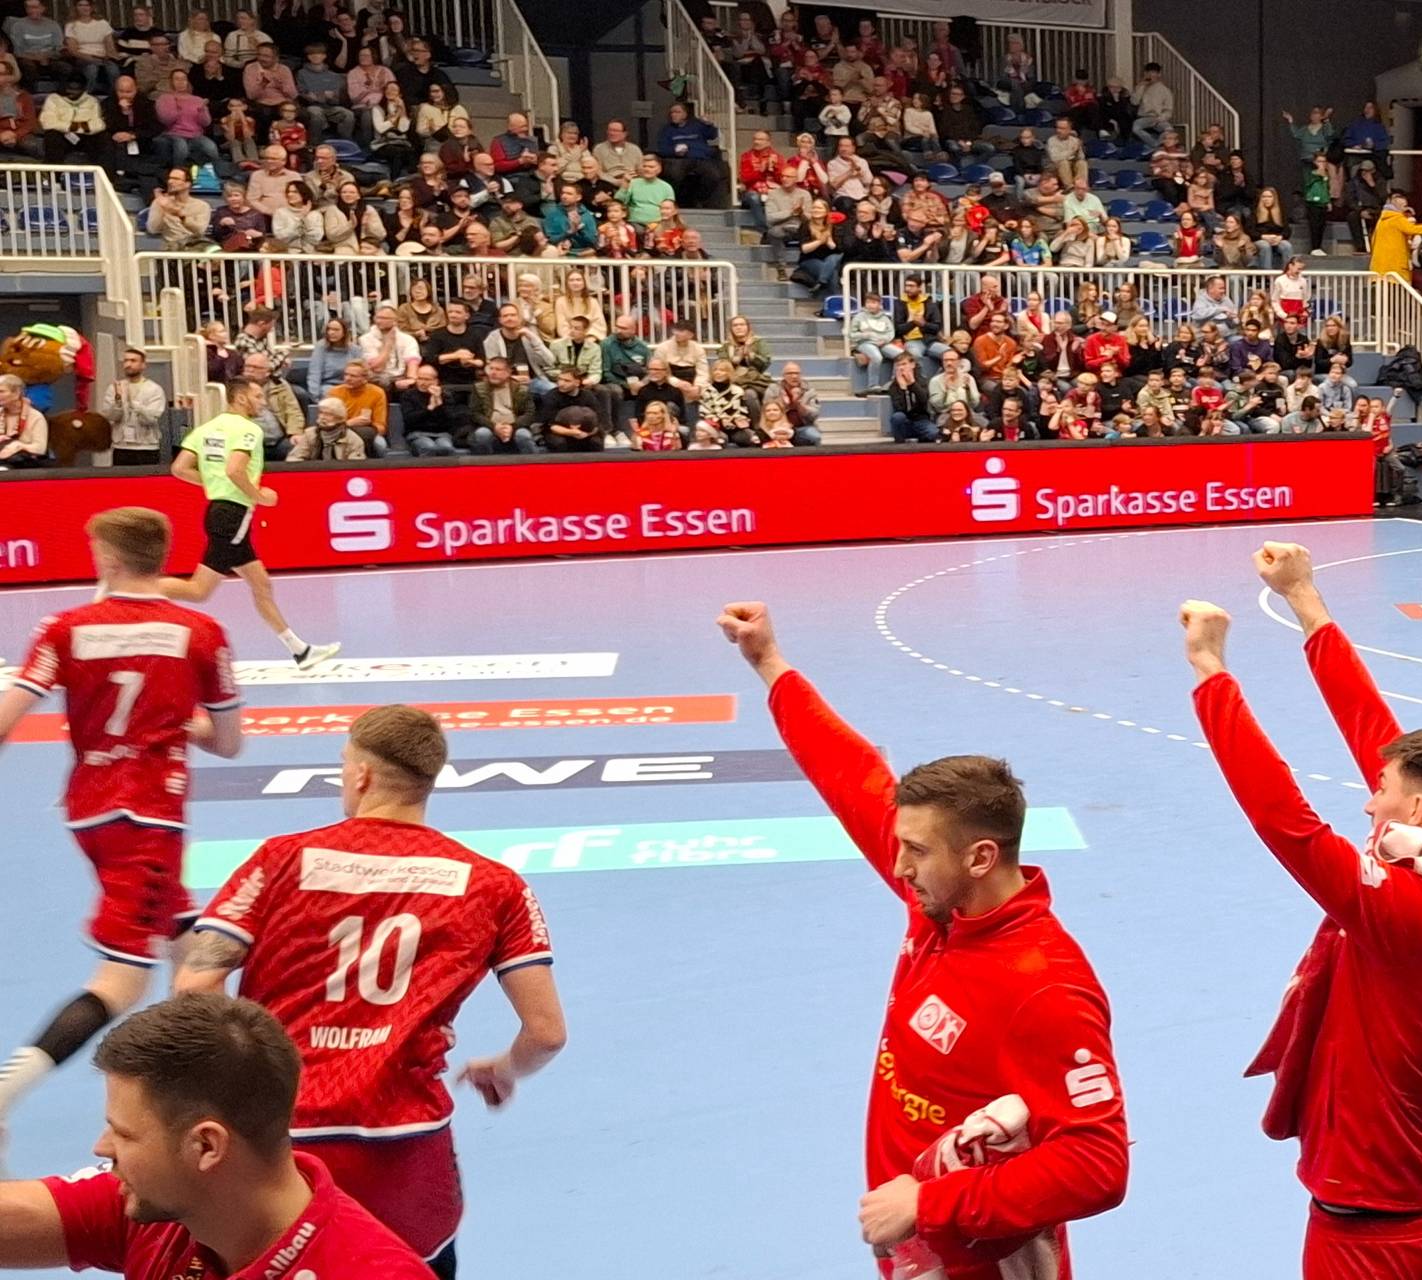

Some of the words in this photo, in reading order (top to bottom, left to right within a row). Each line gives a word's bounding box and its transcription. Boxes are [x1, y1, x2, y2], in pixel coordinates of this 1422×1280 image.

[414, 508, 630, 556] Sparkasse
[639, 503, 755, 538] Essen
[1035, 484, 1199, 526] Sparkasse
[1205, 481, 1294, 512] Essen
[103, 670, 146, 737] 7
[509, 705, 675, 719] Essen
[325, 912, 422, 1006] 10
[264, 1221, 317, 1280] Allbau
